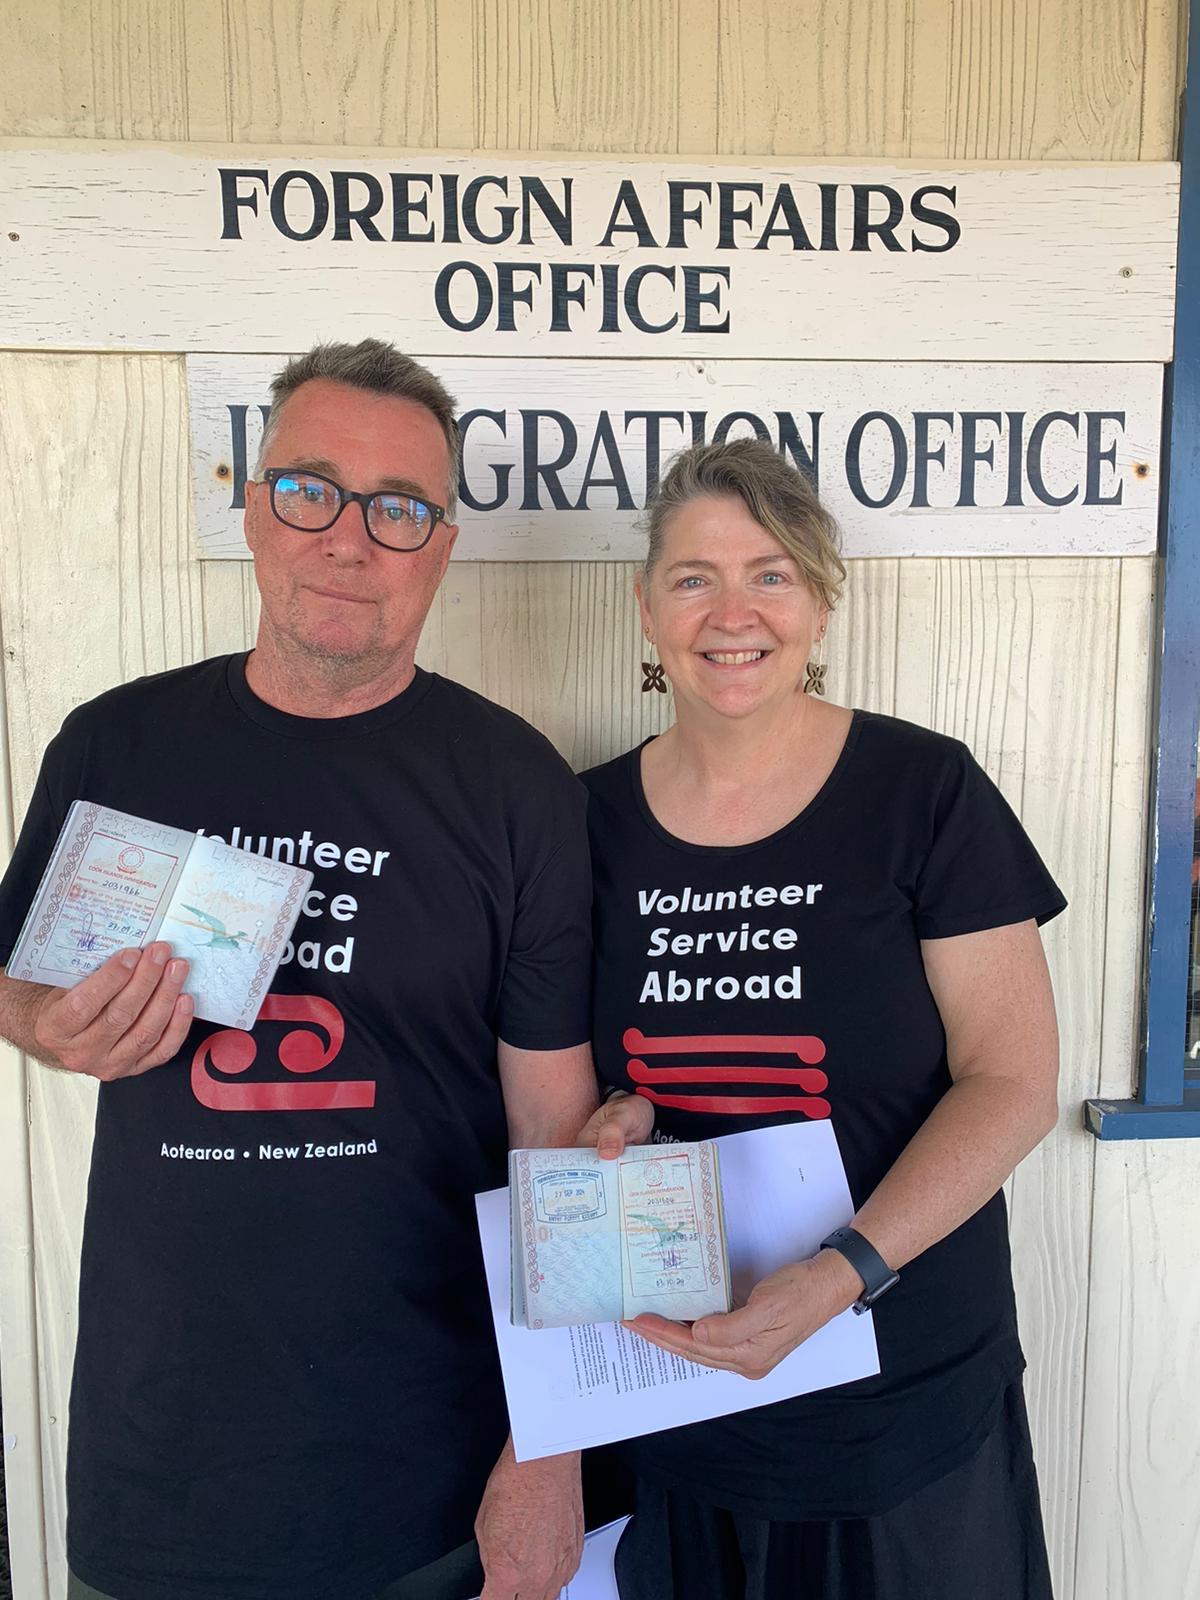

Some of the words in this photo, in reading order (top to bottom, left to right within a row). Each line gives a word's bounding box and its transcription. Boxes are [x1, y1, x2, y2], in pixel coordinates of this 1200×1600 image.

[218, 169, 573, 245] FOREIGN
[598, 180, 961, 252] AFFAIRS
[435, 262, 731, 333] OFFICE
[226, 404, 824, 512] IGRATN
[846, 412, 1125, 508] OFFICE
[638, 883, 823, 916] Volunteer
[647, 922, 798, 957] Service
[639, 966, 802, 1003] Abroad
[160, 1142, 235, 1160] Aotearoa
[259, 1145, 300, 1160] New
[305, 1139, 378, 1159] Zealand
